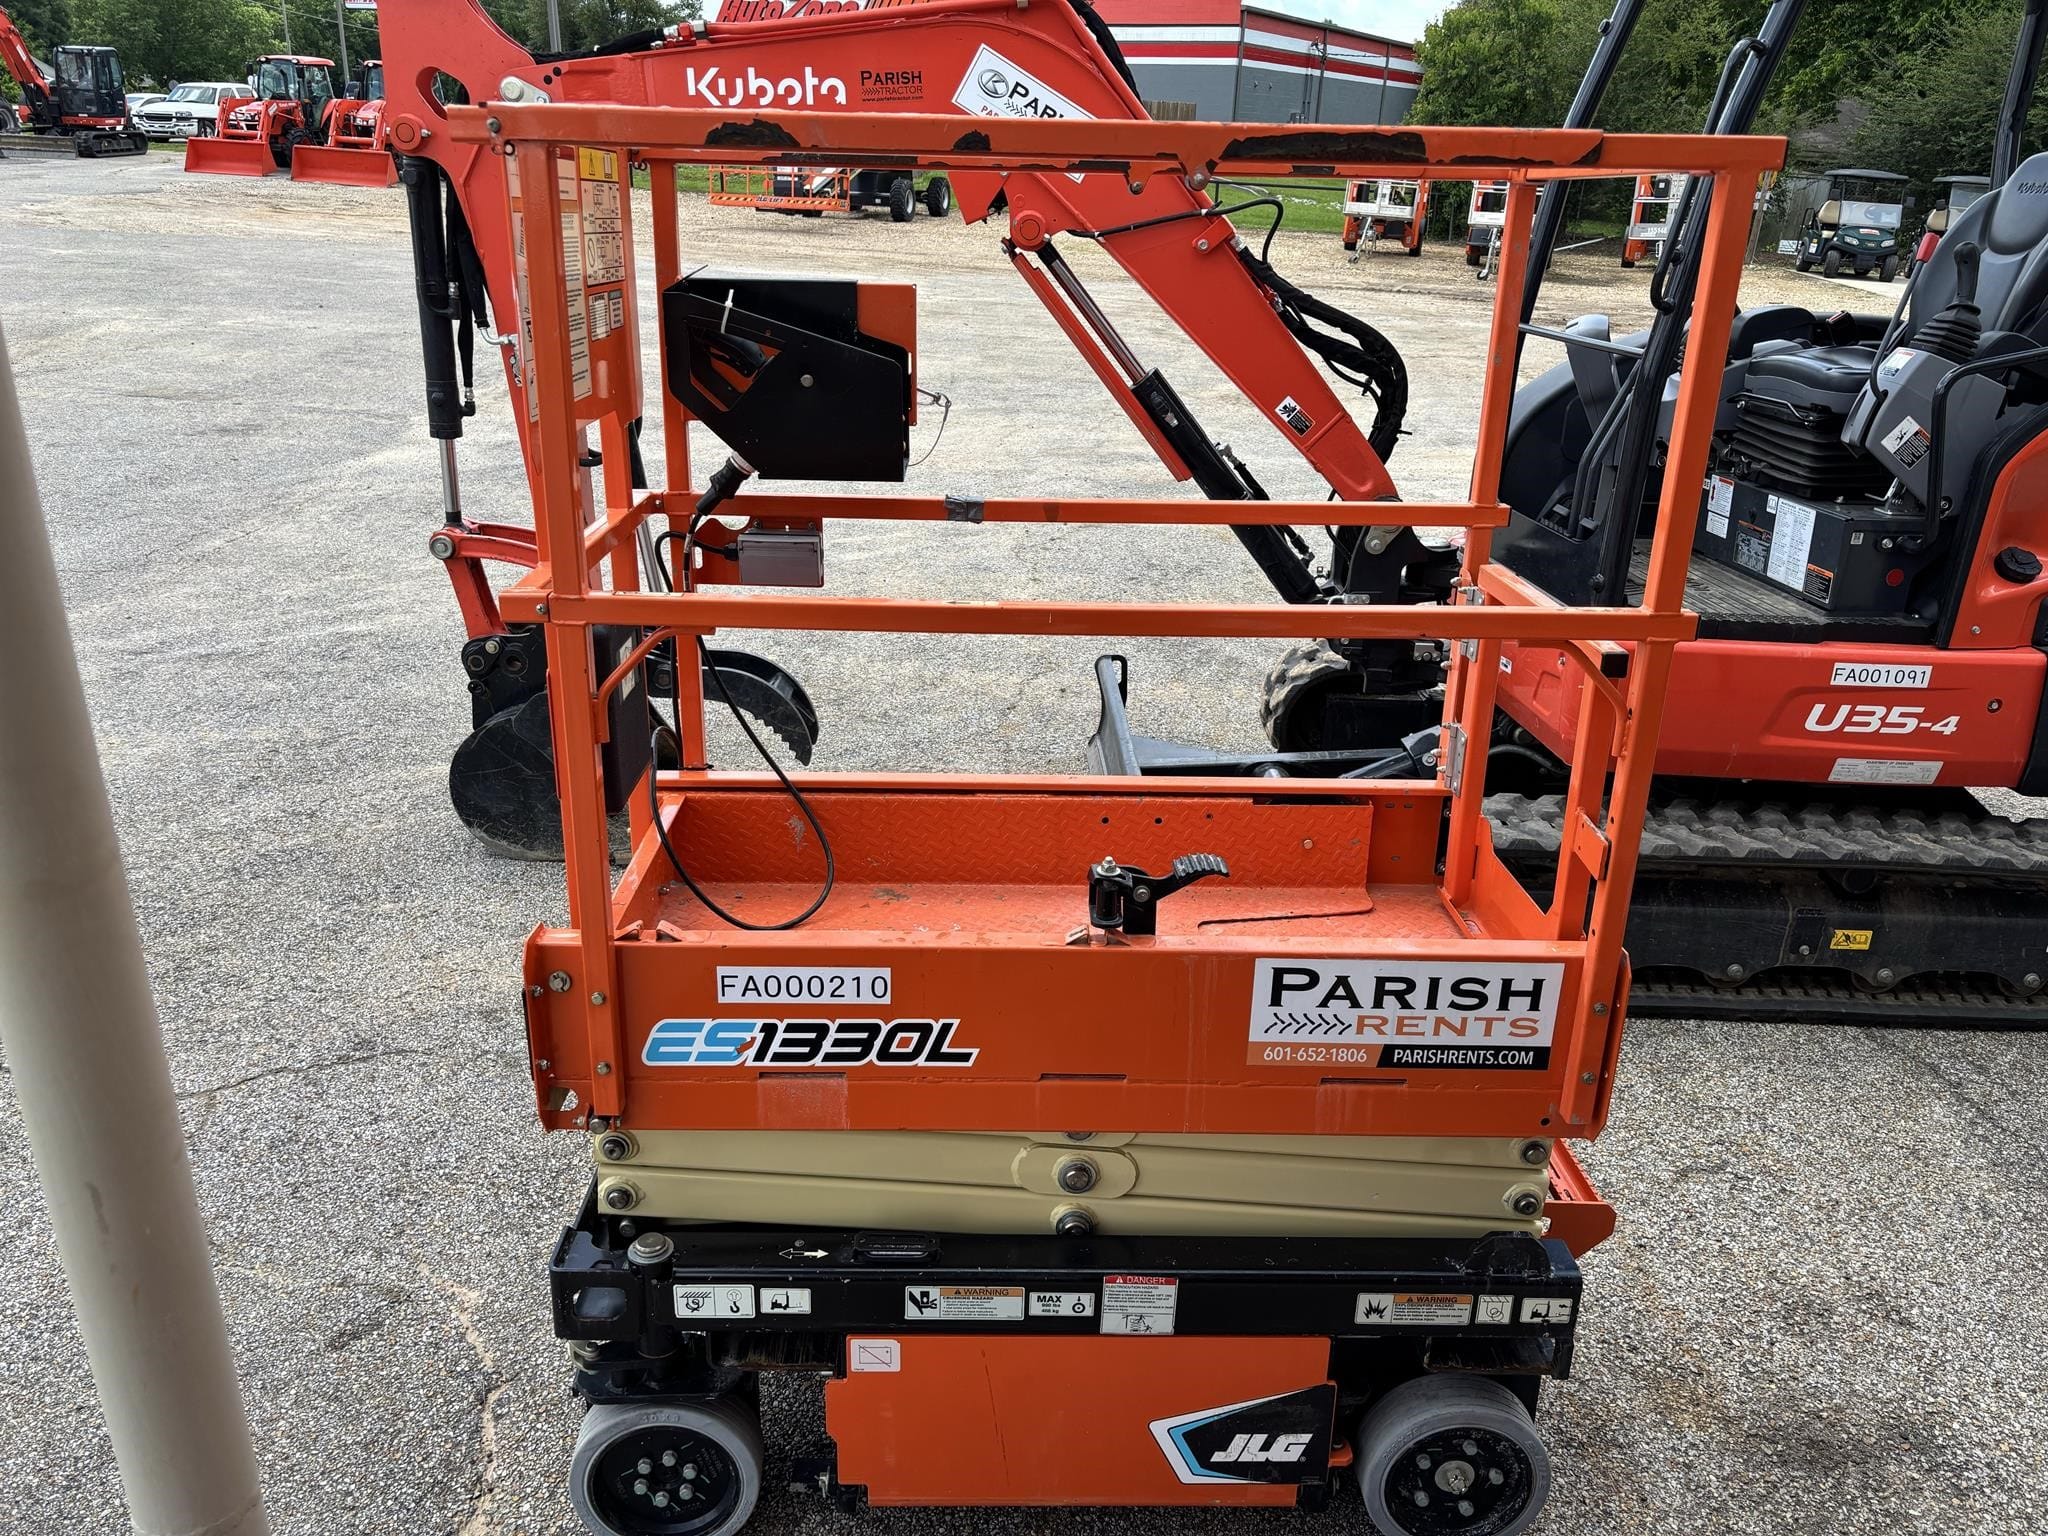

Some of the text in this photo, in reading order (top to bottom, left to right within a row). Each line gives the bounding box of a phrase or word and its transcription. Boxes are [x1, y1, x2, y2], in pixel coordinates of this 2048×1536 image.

[686, 66, 847, 106] Kubota
[860, 70, 922, 86] PARISH
[880, 86, 923, 95] TRACTOR
[1833, 667, 1927, 685] FA001091
[1804, 703, 1961, 736] U35-4
[720, 975, 889, 998] FA000210
[1267, 967, 1546, 1012] PARISH
[1354, 1015, 1541, 1038] RENTS
[643, 1020, 979, 1066] ES1330L
[1263, 1047, 1368, 1063] 601-652-1806
[1393, 1049, 1535, 1066] PARISHRENTS.COM
[1127, 1276, 1166, 1284] DANGER
[964, 1288, 1009, 1296] WARNING
[1037, 1295, 1062, 1303] MAX
[1210, 1433, 1313, 1462] JLG
